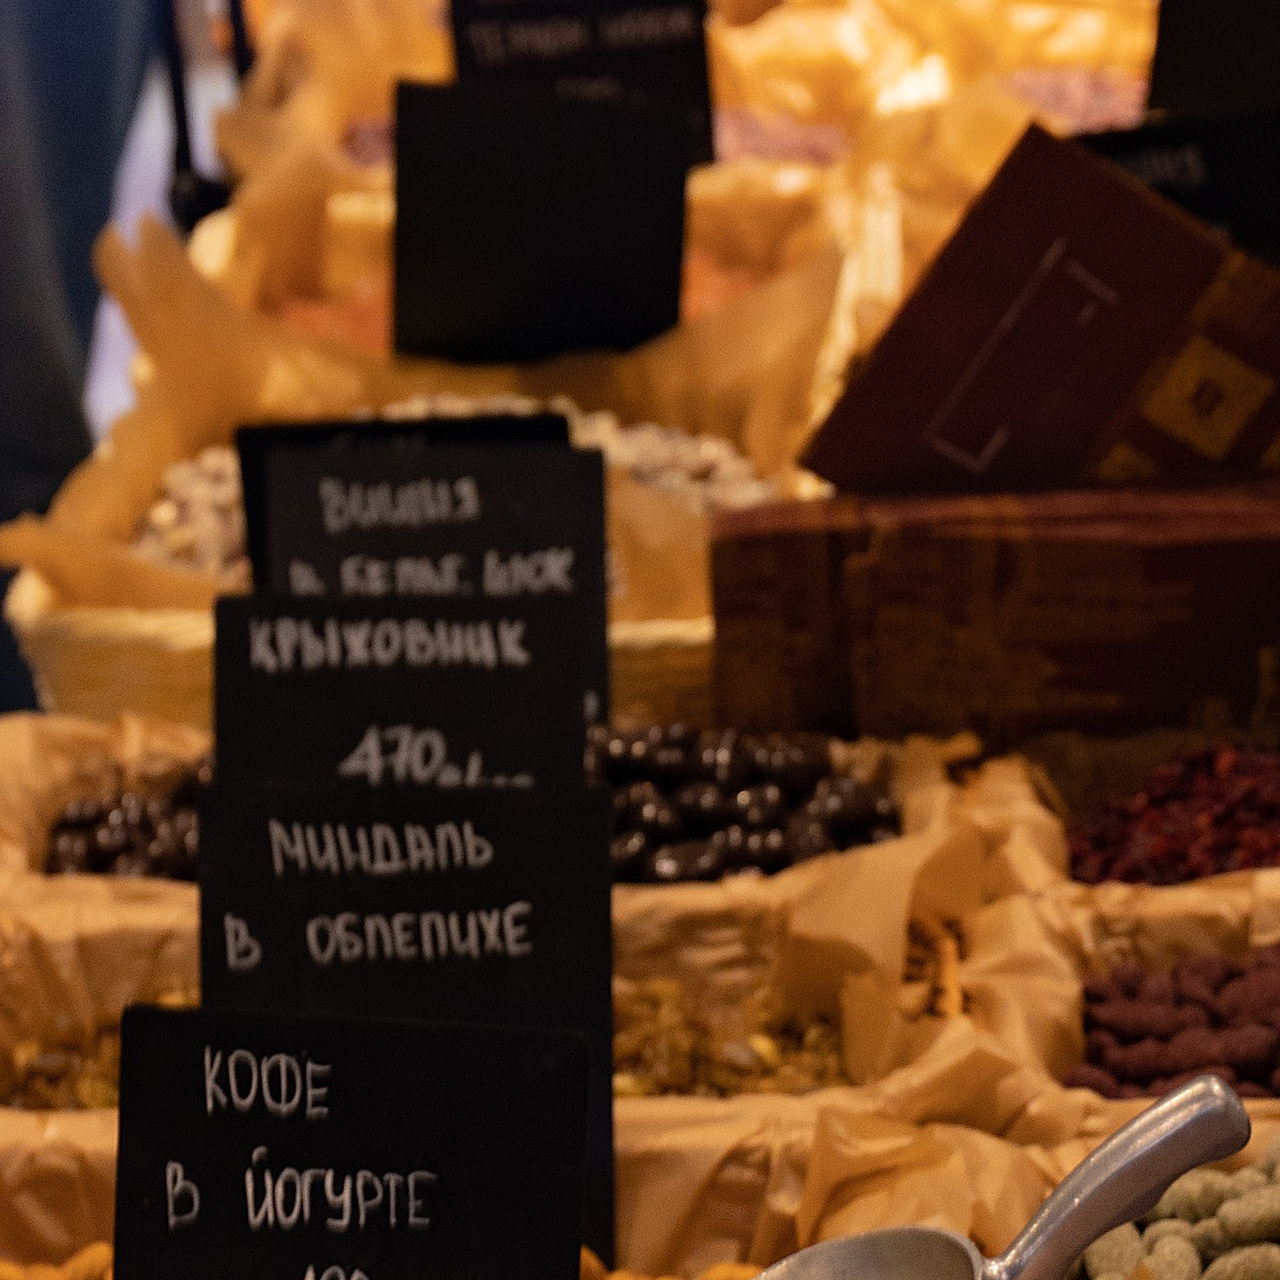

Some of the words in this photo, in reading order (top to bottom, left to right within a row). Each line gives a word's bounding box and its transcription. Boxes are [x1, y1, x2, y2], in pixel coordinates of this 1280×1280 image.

[251, 618, 528, 671] КРЫЖОВНИК
[269, 819, 493, 874] МИНДАЛЬ
[224, 914, 261, 968] В
[307, 902, 530, 962] ОБЛЕПИХЕ
[204, 1047, 330, 1116] КОФЕ
[166, 1161, 199, 1227] В
[245, 1146, 431, 1229] ЙОГУРТЕ
